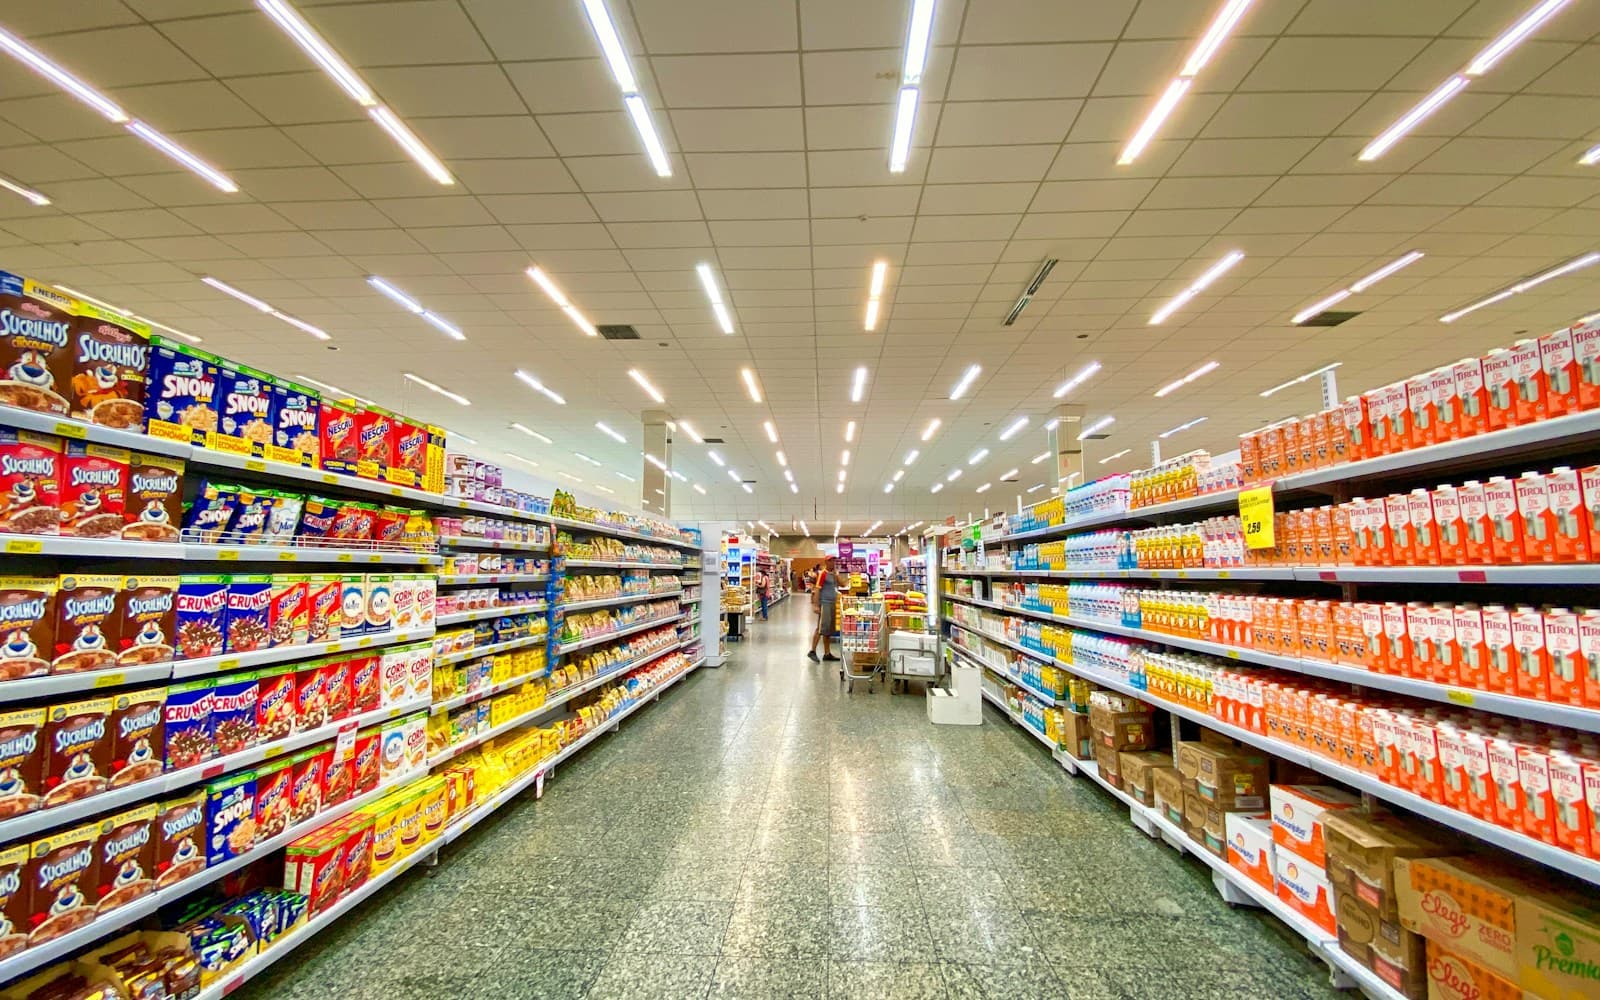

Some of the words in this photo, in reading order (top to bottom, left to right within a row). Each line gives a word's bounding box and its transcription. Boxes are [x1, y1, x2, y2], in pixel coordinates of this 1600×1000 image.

[0, 309, 69, 347] SUCRILHOS
[80, 334, 147, 371] SUCRILHOS
[1541, 340, 1570, 355] TIROL
[1484, 361, 1509, 373] TIROL
[1511, 351, 1538, 365] TIROL
[162, 374, 215, 398] SNOW
[1431, 378, 1453, 389] TIROL
[1456, 371, 1480, 382] TIROL
[1409, 384, 1430, 396] TIROL
[226, 393, 270, 415] SNOW
[280, 408, 316, 429] SNOW
[327, 418, 354, 437] NESCAU
[361, 423, 389, 443] NESCAU
[400, 433, 424, 453] NESCAU
[2, 455, 54, 476] SUCRILHOS
[72, 467, 121, 486] SUCRILHOS
[132, 474, 178, 493] SUCRILHOS
[1486, 491, 1513, 500] TIROL
[1518, 487, 1546, 498] TIROL
[1549, 482, 1577, 493] TIROL
[1435, 498, 1457, 508] TIROL
[1461, 494, 1484, 505] TIROL
[129, 592, 173, 618] SUCRILHOS
[178, 592, 226, 610] CRUNCH
[228, 590, 271, 609] CRUNCH
[279, 588, 305, 609] NESCAU
[316, 587, 340, 607] NESCAU
[393, 589, 412, 604] CORN
[65, 593, 116, 620] SUCRILHOS
[1455, 619, 1480, 629] TIROL
[1485, 620, 1509, 631] TIROL
[1513, 622, 1542, 633] TIROL
[1547, 624, 1576, 635] TIROL
[386, 661, 405, 679] CORN
[411, 657, 428, 673] CORN
[261, 680, 294, 711] NESCAU
[300, 672, 326, 702] NESCAU
[166, 694, 215, 721] CRUNCH
[214, 685, 259, 711] CRUNCH
[121, 706, 161, 738] SUCRILHOS
[56, 718, 105, 752] SUCRILHOS
[408, 728, 424, 746] CORN
[1462, 746, 1486, 760] TIROL
[1490, 753, 1515, 767] TIROL
[1519, 760, 1547, 776] TIROL
[1551, 768, 1579, 784] TIROL
[163, 806, 202, 840] SUCRILHOS
[213, 796, 254, 834] SNOW
[105, 824, 151, 863] SUCRILHOS
[39, 845, 92, 889] SUCRILHOS
[1479, 924, 1511, 946] ZERO
